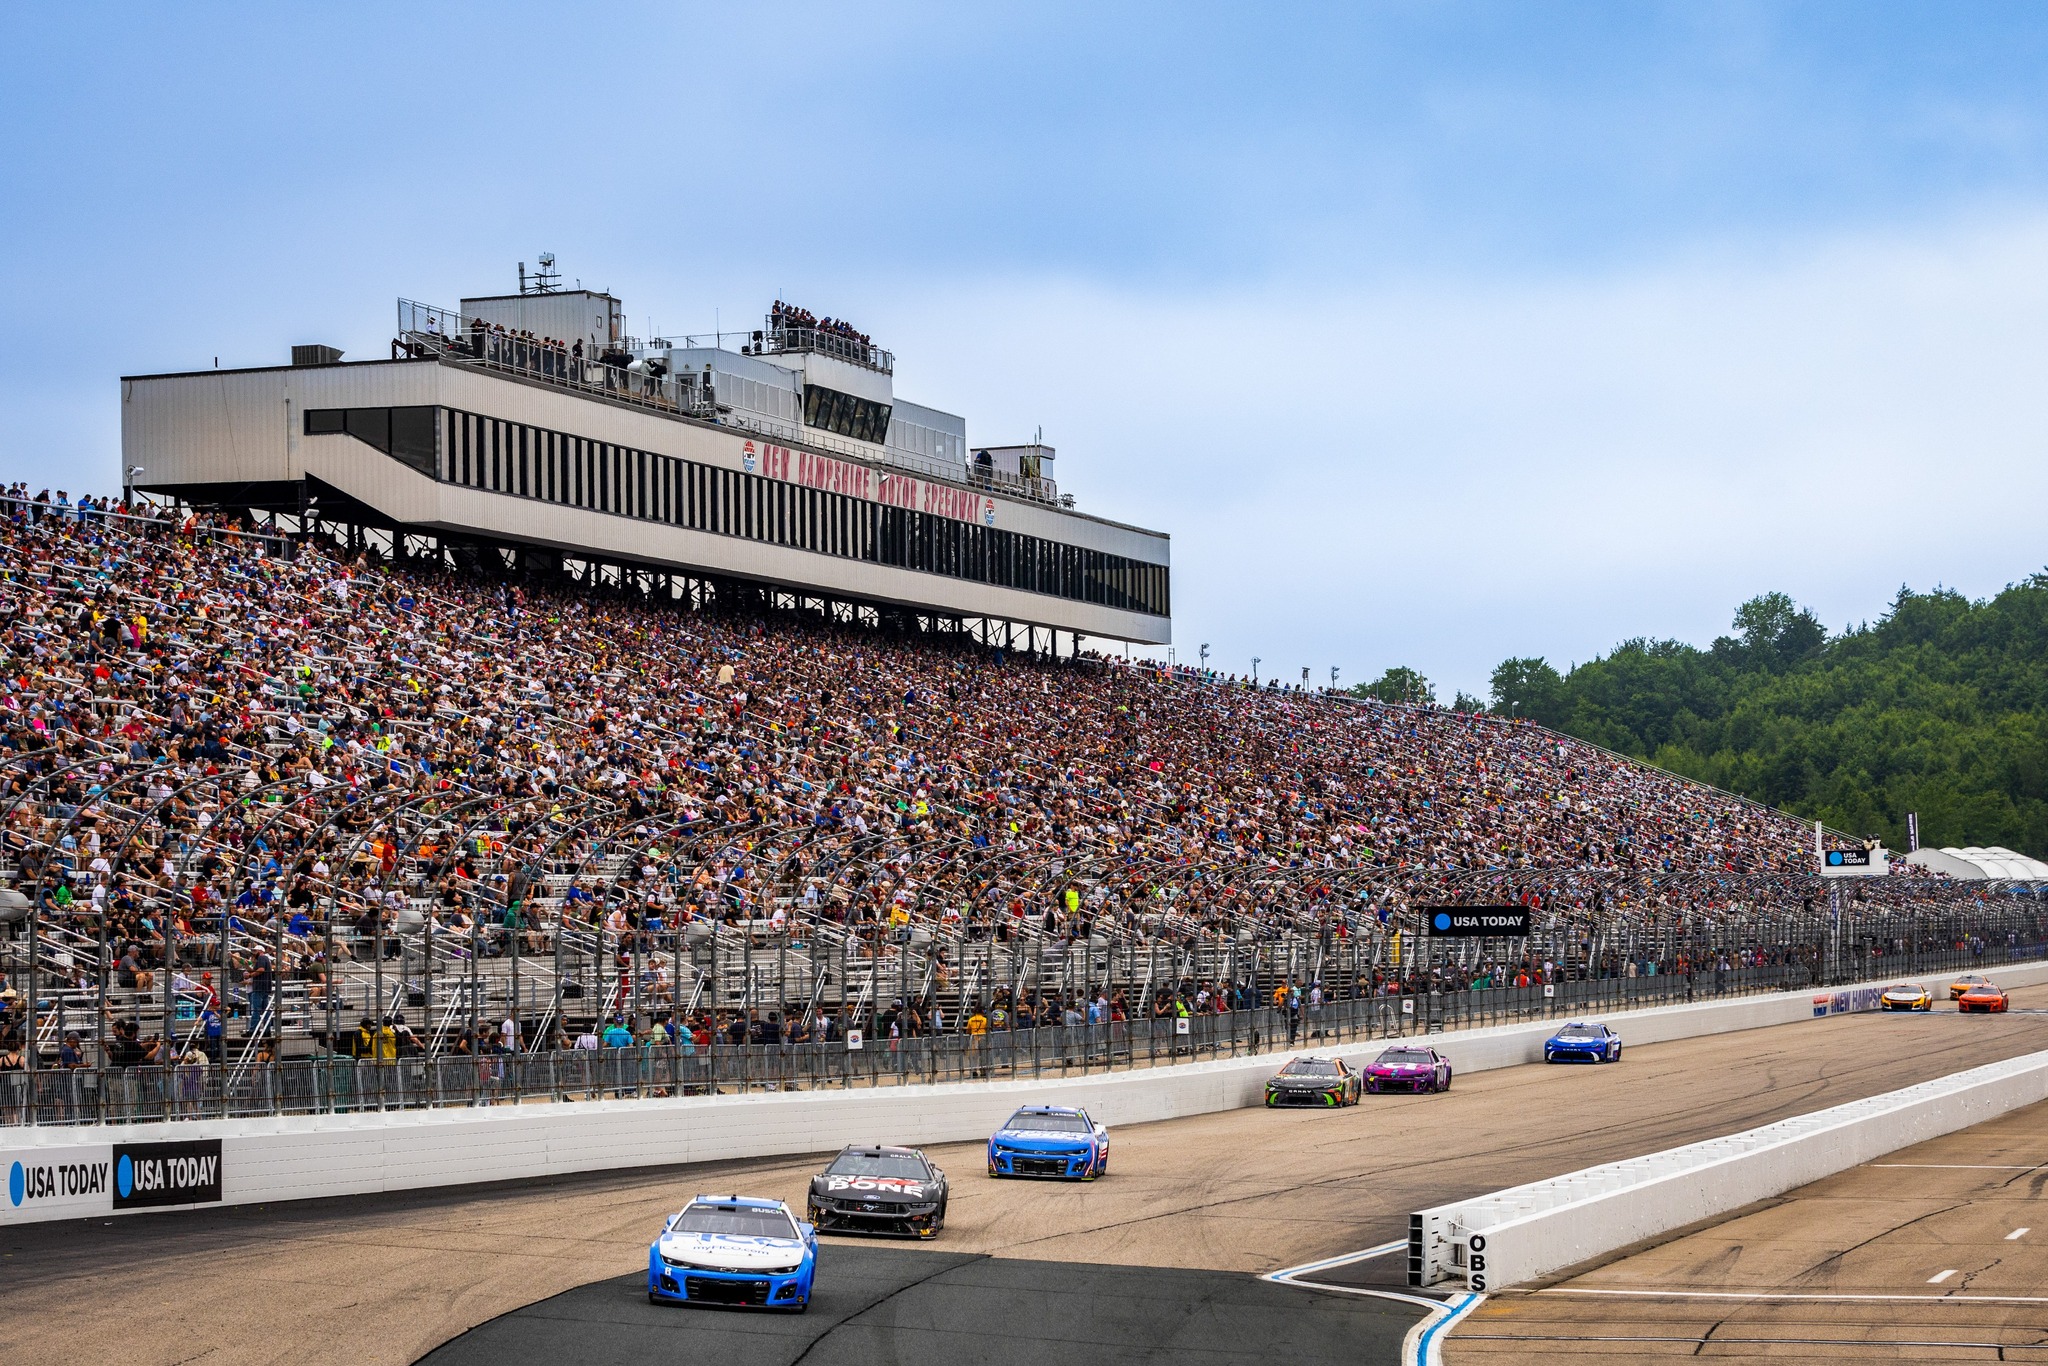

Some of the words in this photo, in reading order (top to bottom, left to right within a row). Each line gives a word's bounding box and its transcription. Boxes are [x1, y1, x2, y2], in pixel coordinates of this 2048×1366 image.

[763, 444, 791, 480] NEW
[799, 453, 870, 499] HAMPSHIRE
[877, 473, 917, 509] MOTOR
[924, 483, 981, 523] SPEEDWAY
[1453, 917, 1479, 927] USA
[1481, 916, 1523, 927] TODAY
[26, 1166, 56, 1199] USA
[58, 1162, 108, 1196] TODAY
[133, 1159, 165, 1191] USA
[167, 1155, 218, 1189] TODAY
[827, 1180, 925, 1199] BONE
[751, 1207, 783, 1215] BUSCH
[693, 1244, 770, 1256] myFICO.com
[1469, 1234, 1486, 1291] OBS
